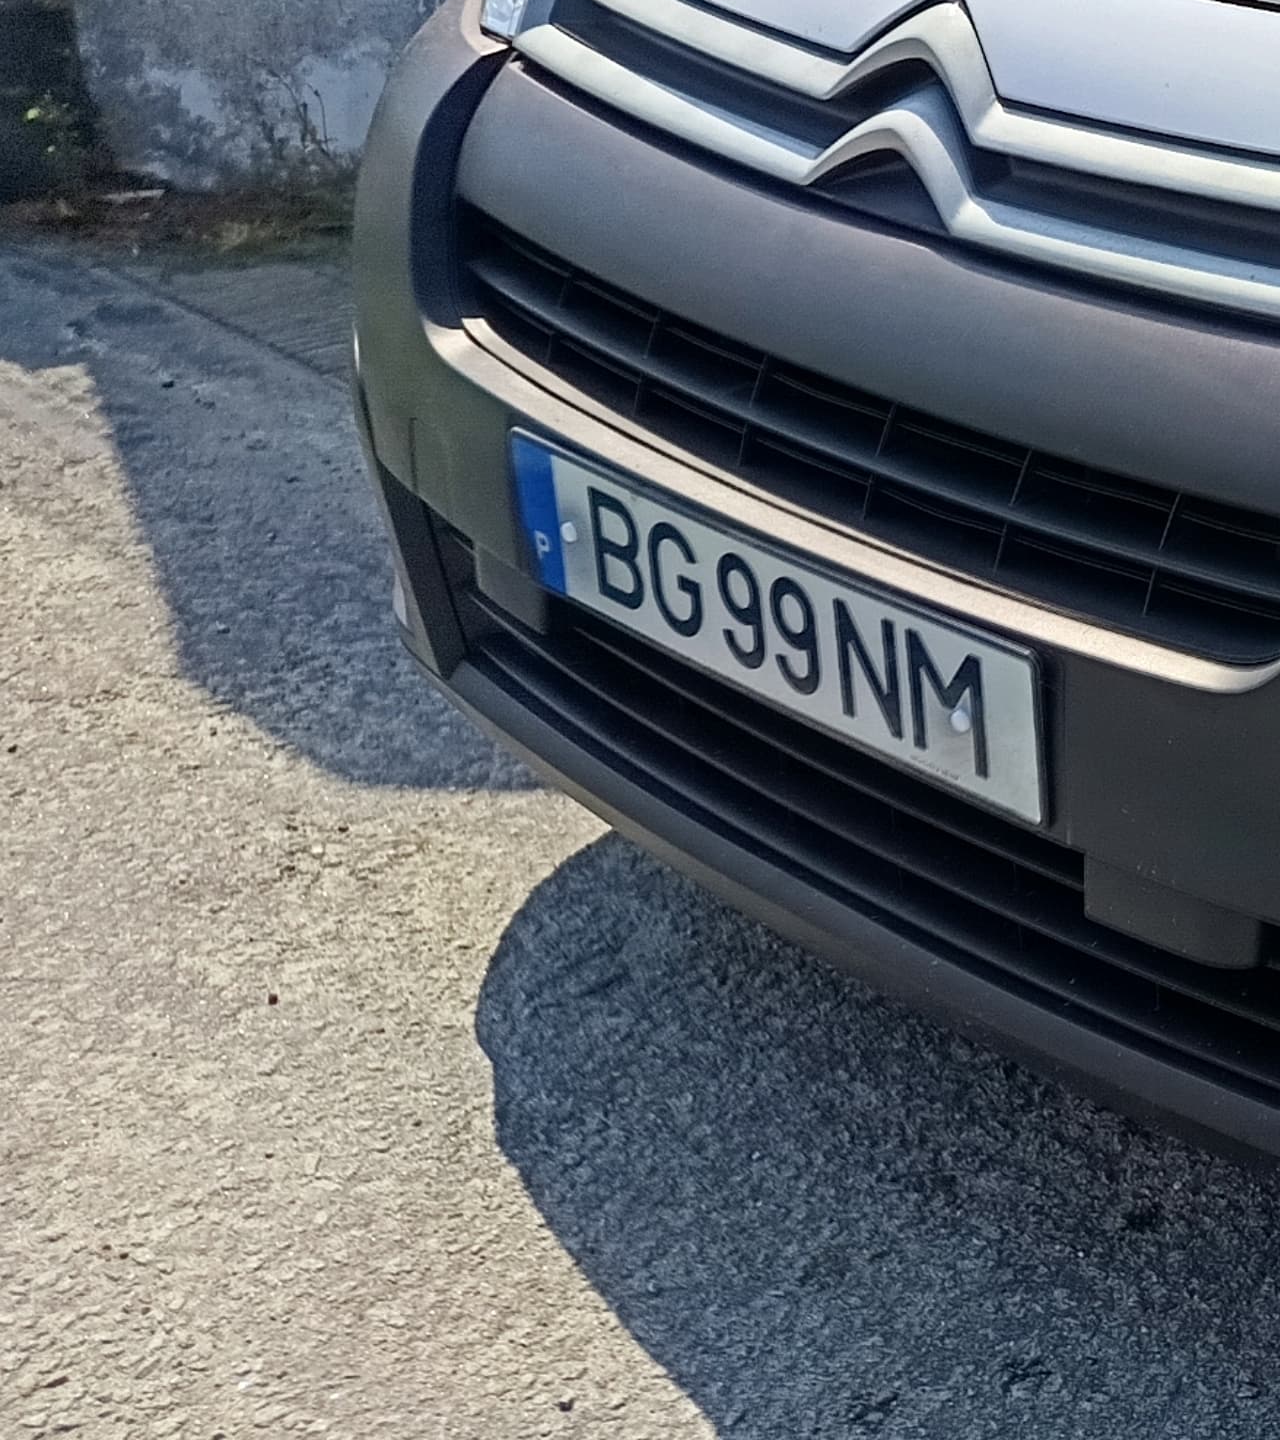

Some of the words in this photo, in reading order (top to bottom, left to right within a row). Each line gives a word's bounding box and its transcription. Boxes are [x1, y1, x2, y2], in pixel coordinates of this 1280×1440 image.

[533, 529, 551, 560] P
[587, 485, 703, 638] BG
[716, 551, 821, 696] 99
[832, 597, 990, 780] NM
